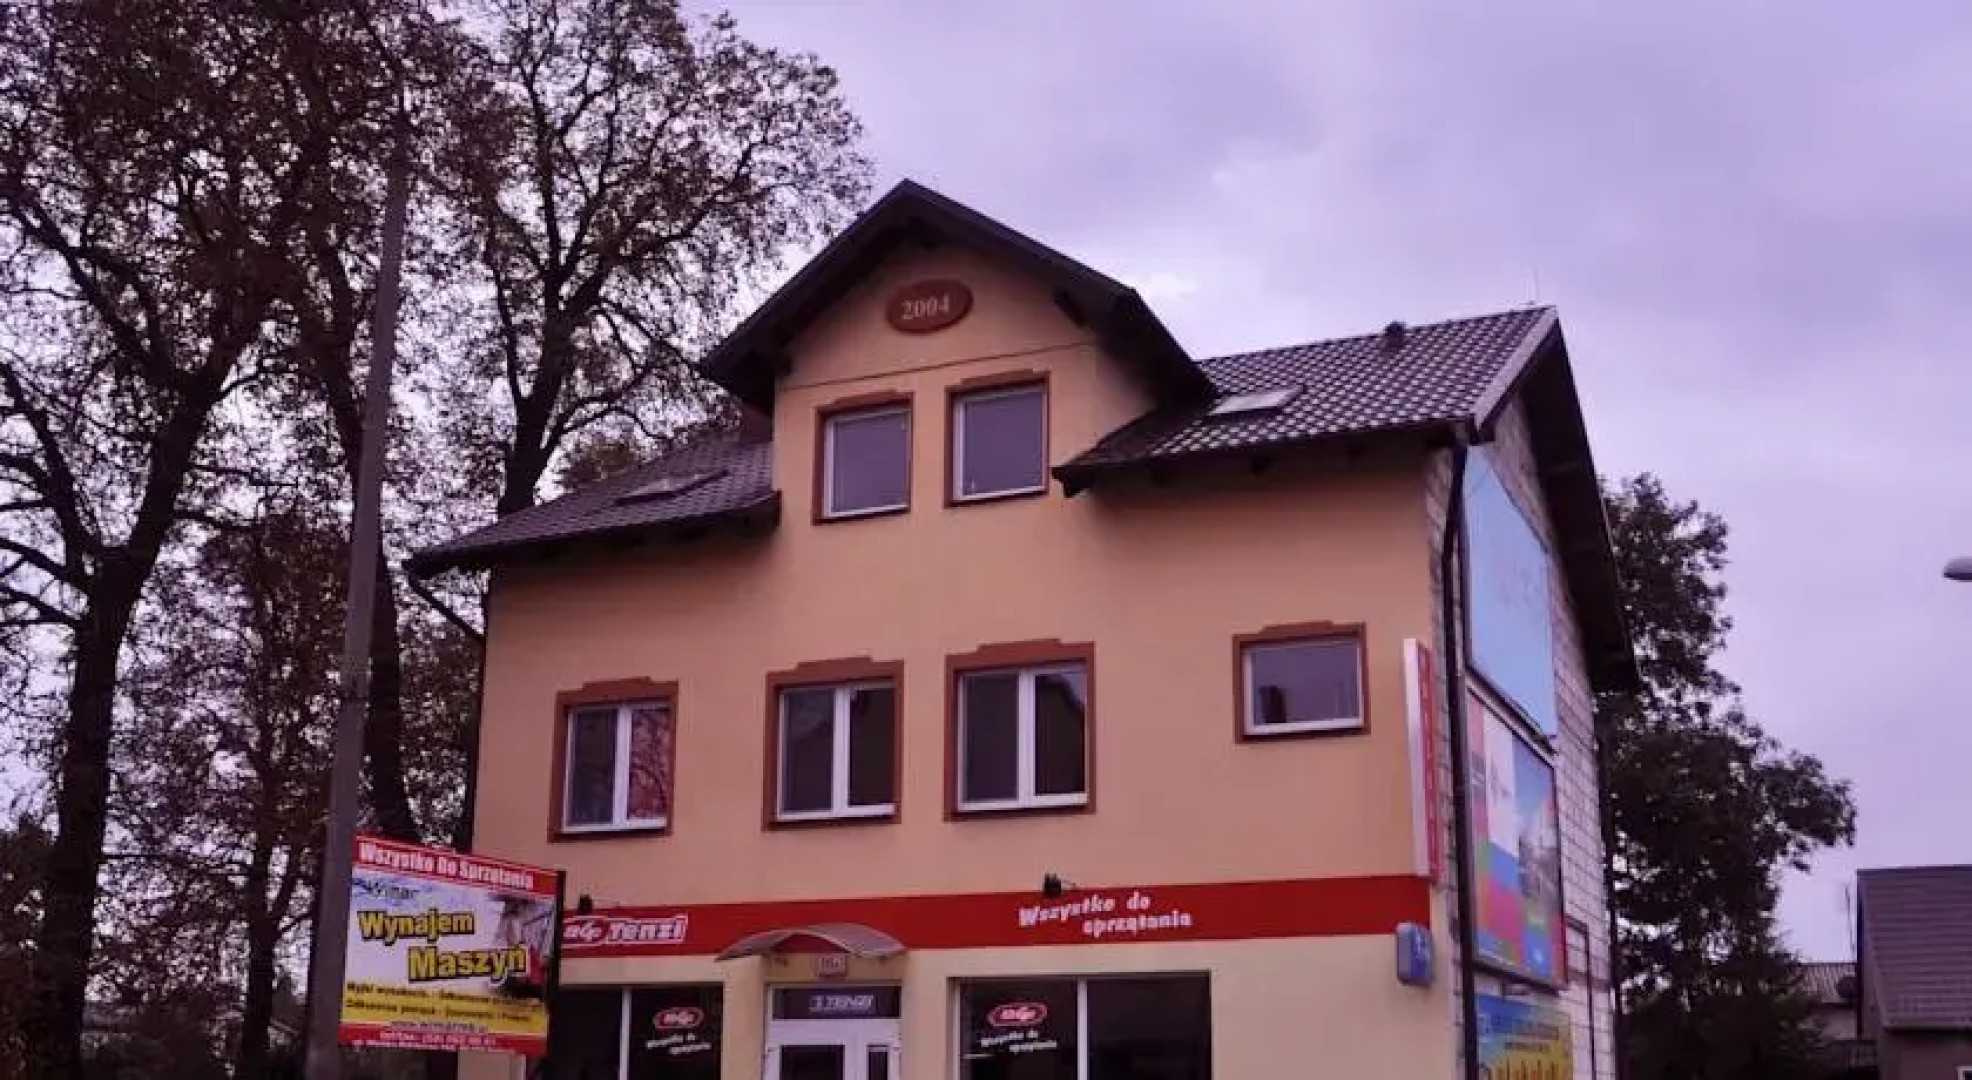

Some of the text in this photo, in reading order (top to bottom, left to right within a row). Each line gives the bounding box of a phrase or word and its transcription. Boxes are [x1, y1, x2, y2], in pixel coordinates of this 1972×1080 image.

[901, 293, 949, 320] 2004
[357, 908, 475, 946] Wynajem
[1018, 890, 1150, 927] Wszystko do
